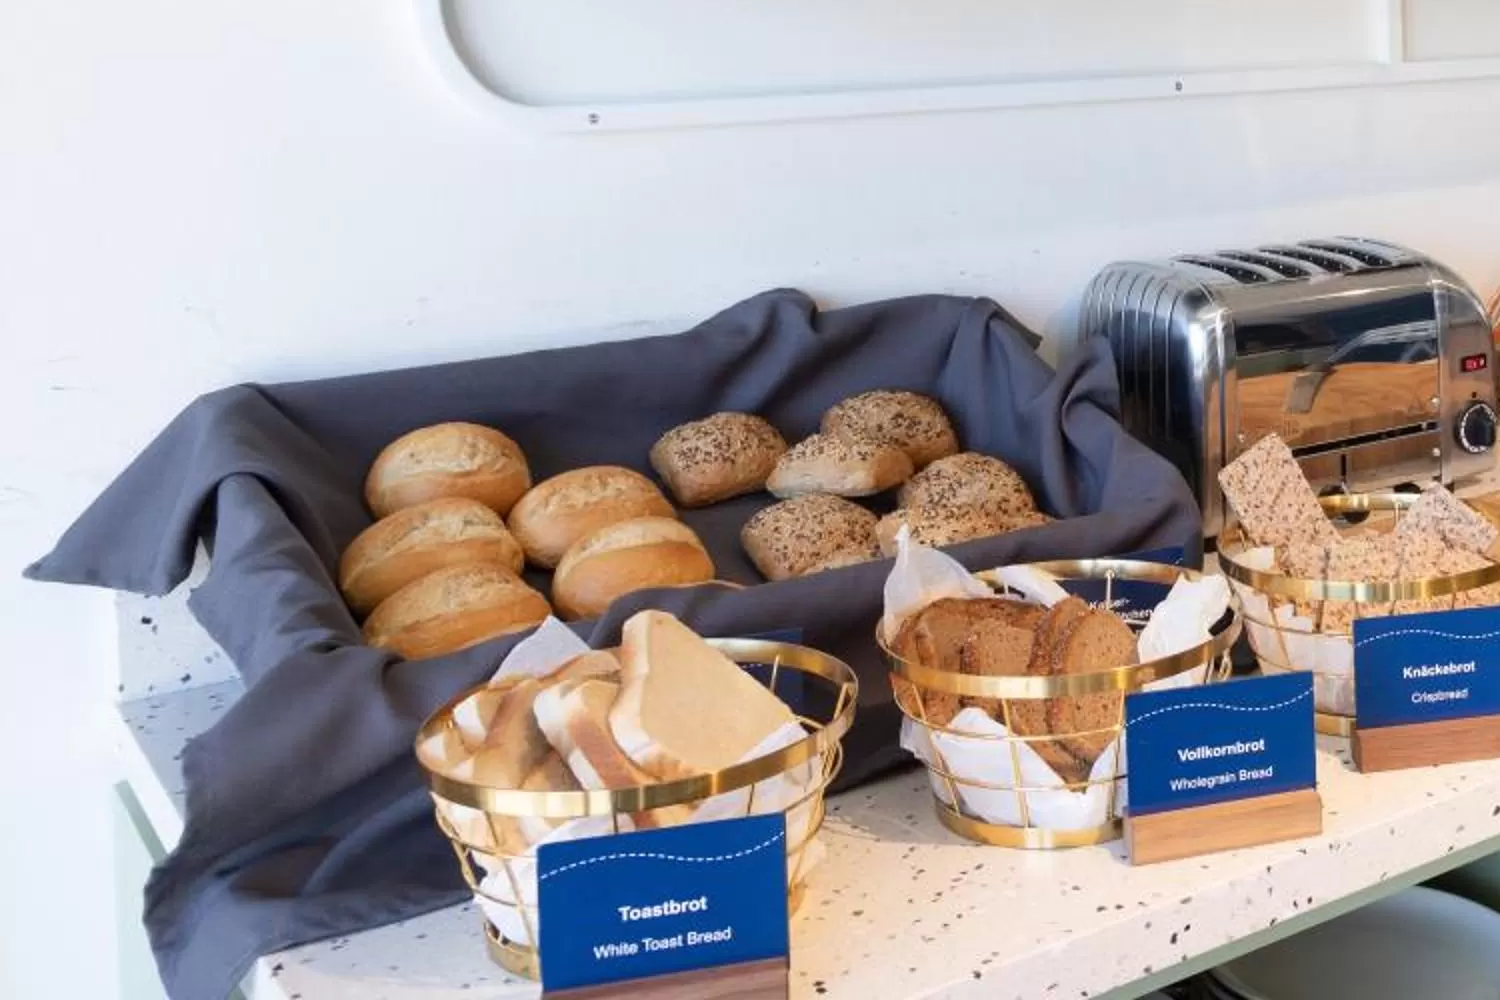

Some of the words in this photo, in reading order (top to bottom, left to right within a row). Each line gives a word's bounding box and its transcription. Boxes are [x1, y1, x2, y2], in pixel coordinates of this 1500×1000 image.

[1402, 660, 1476, 680] Knäckebrot
[1411, 687, 1470, 704] Crispbread
[1177, 738, 1266, 762] Vollkornbrot
[1169, 770, 1238, 792] Wholegrain
[1239, 765, 1274, 781] Bread
[617, 896, 709, 922] Toastbrot
[593, 941, 639, 961] White
[641, 933, 684, 953] Toast
[687, 926, 733, 946] Bread
